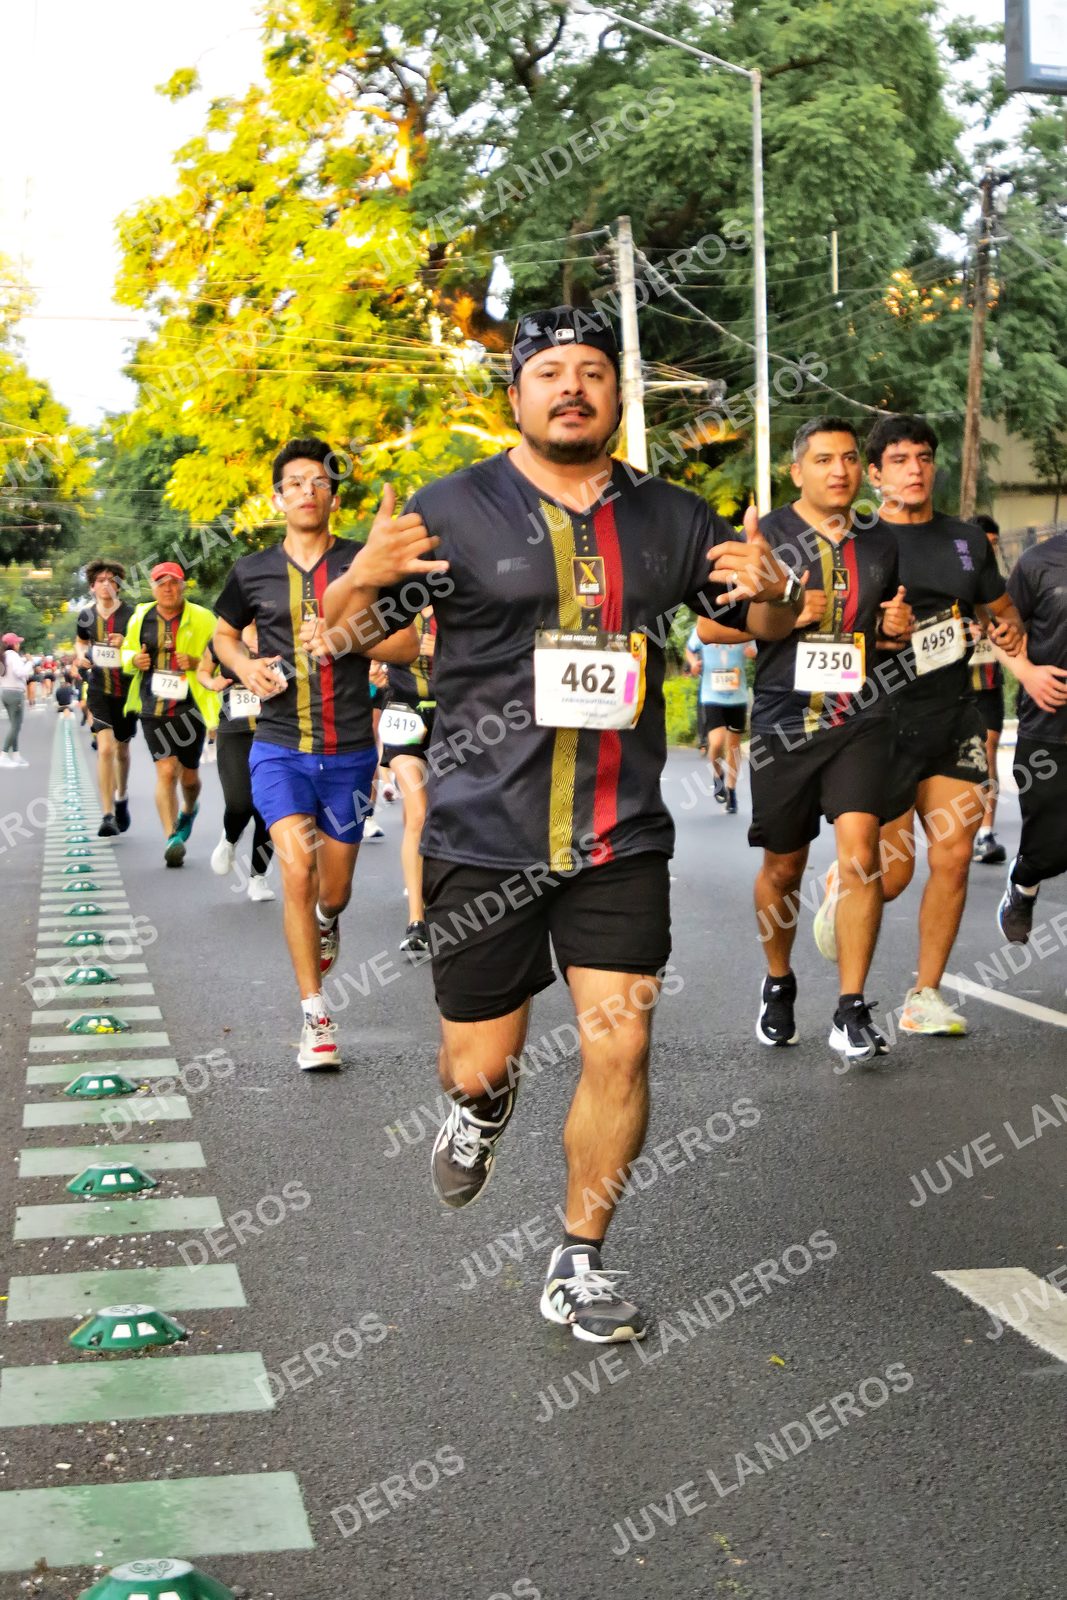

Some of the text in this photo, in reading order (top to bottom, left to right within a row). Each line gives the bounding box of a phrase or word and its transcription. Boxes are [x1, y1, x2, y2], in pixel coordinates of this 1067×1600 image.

[921, 626, 955, 653] 4959
[96, 649, 116, 659] 7492
[806, 651, 853, 670] 7350
[161, 678, 179, 689] 774
[561, 662, 616, 694] 462
[236, 693, 257, 705] 386
[385, 715, 417, 732] 3419
